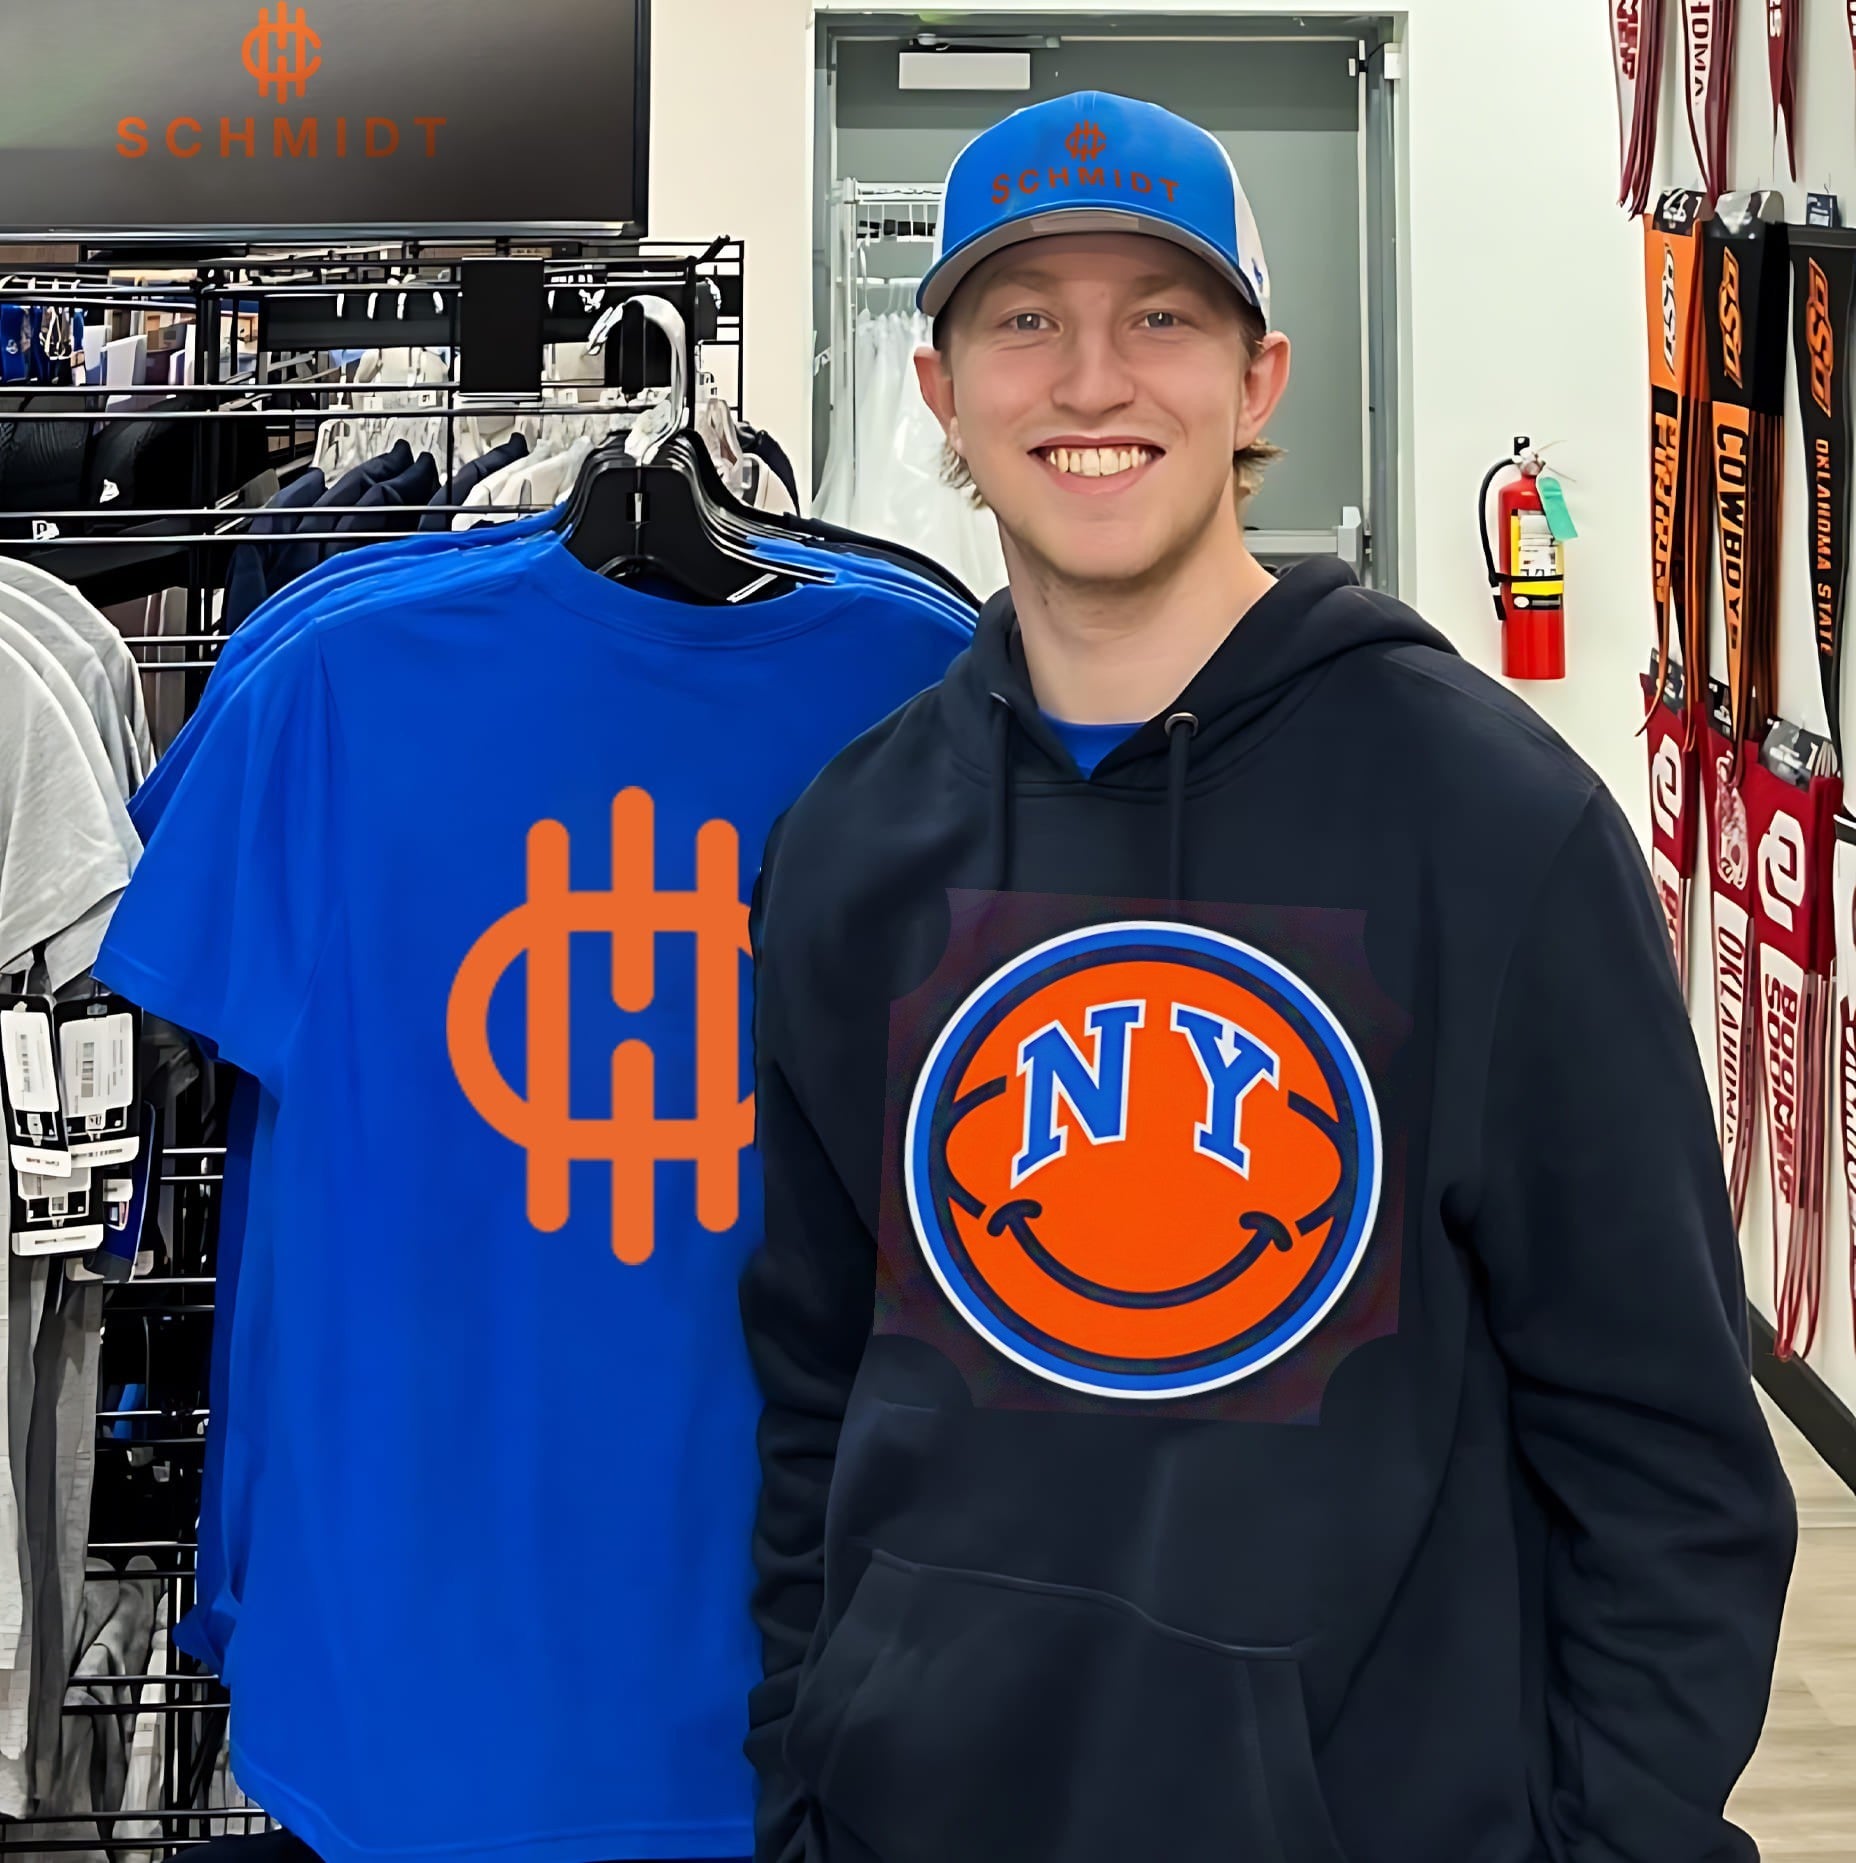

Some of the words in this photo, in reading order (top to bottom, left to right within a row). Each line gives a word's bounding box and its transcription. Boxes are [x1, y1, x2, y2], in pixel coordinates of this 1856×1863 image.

[115, 116, 448, 159] SCHMIDT
[991, 167, 1180, 205] SCHMIDT
[1814, 438, 1833, 571] OKLAHOMA
[1816, 582, 1834, 657] STATE
[1717, 926, 1746, 1144] OKLAHOMA
